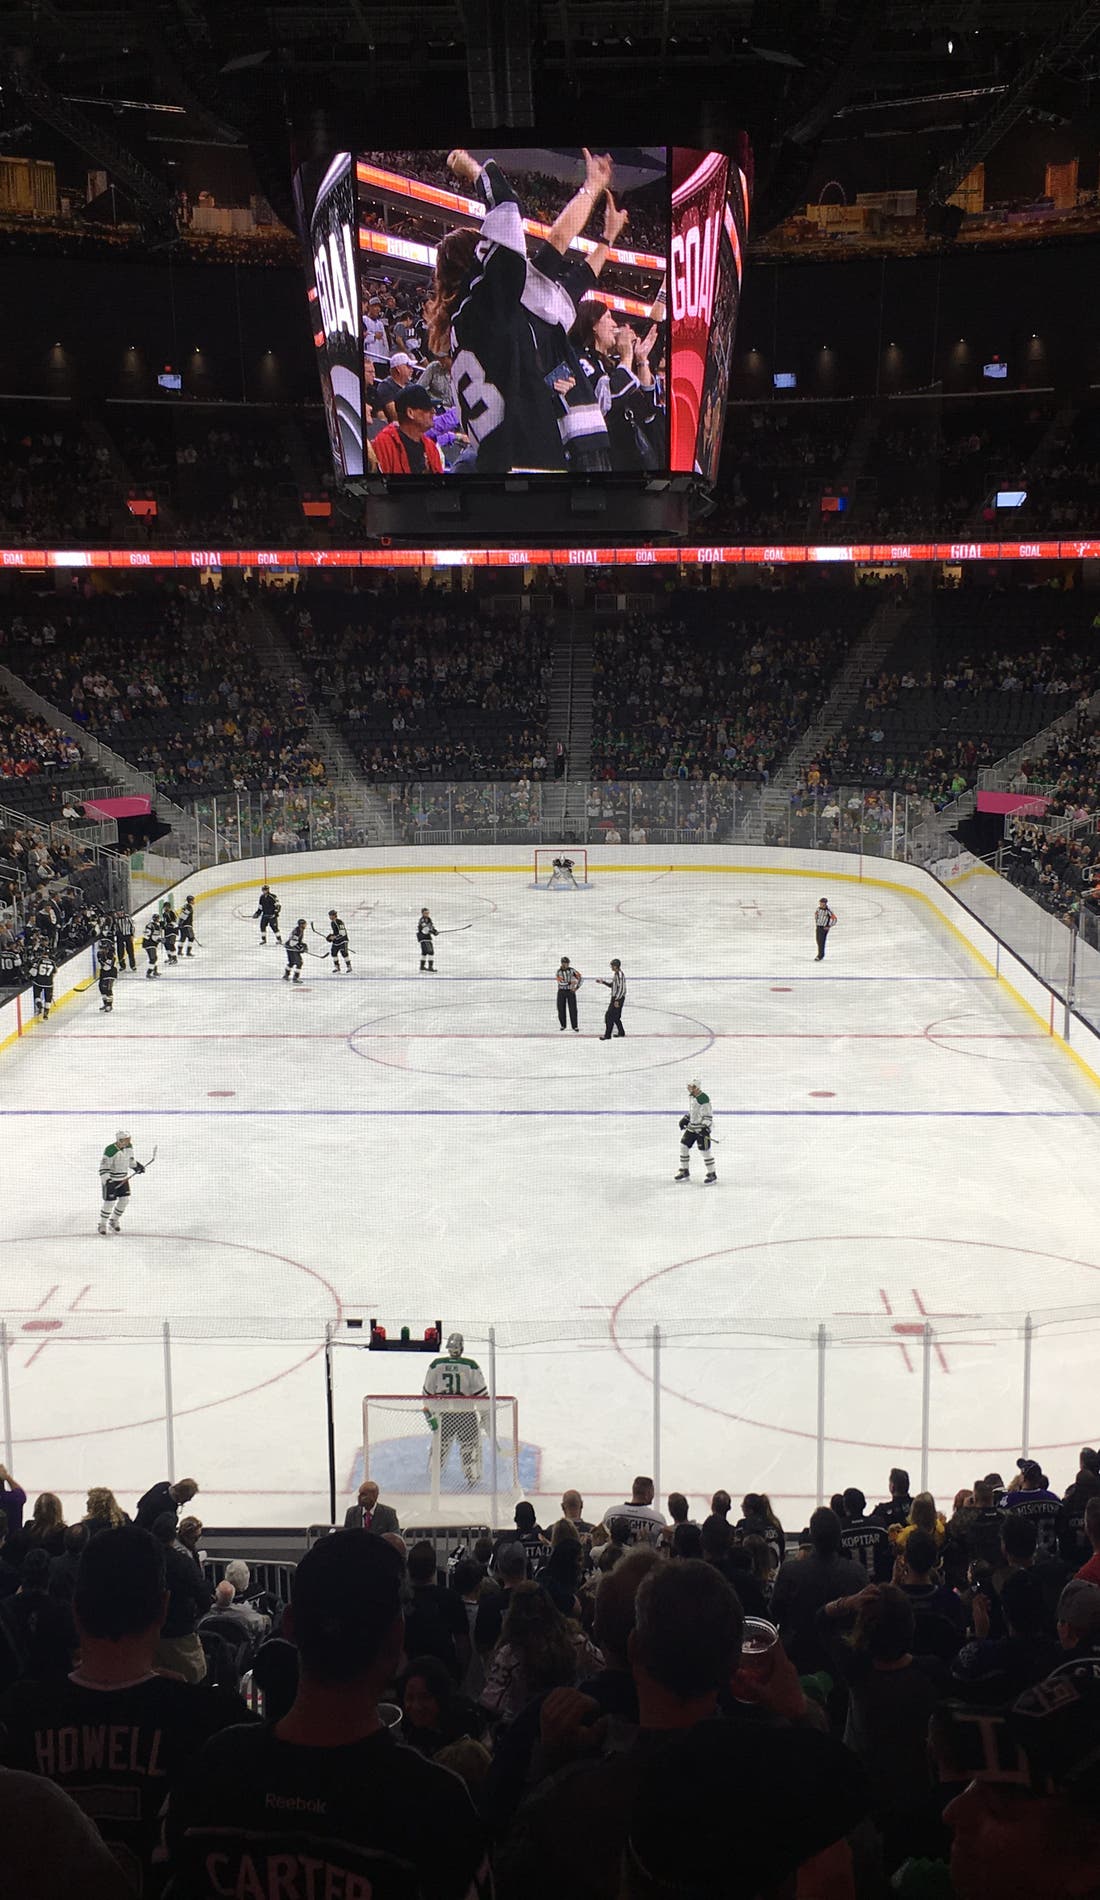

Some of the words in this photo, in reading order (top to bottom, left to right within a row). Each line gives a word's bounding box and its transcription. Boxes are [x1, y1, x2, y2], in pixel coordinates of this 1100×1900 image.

[569, 551, 600, 564] GOAL
[636, 551, 657, 562] GOAL
[698, 548, 726, 562] GOAL
[764, 549, 785, 560] GOAL
[891, 547, 912, 559] GOAL
[951, 544, 983, 559] GOAL
[1019, 545, 1041, 557] GOAL
[3, 553, 26, 565] GOAL
[130, 553, 153, 565] GOAL
[191, 552, 222, 566] GOAL
[258, 553, 280, 565] GOAL
[509, 552, 530, 564] GOAL
[1, 958, 14, 970] 10
[39, 963, 54, 977] 67
[442, 1373, 462, 1395] 31
[841, 1533, 880, 1549] KOPITAR
[34, 1724, 167, 1777] HOWELL
[264, 1792, 328, 1815] Reebok
[204, 1850, 374, 1900] CARTER
